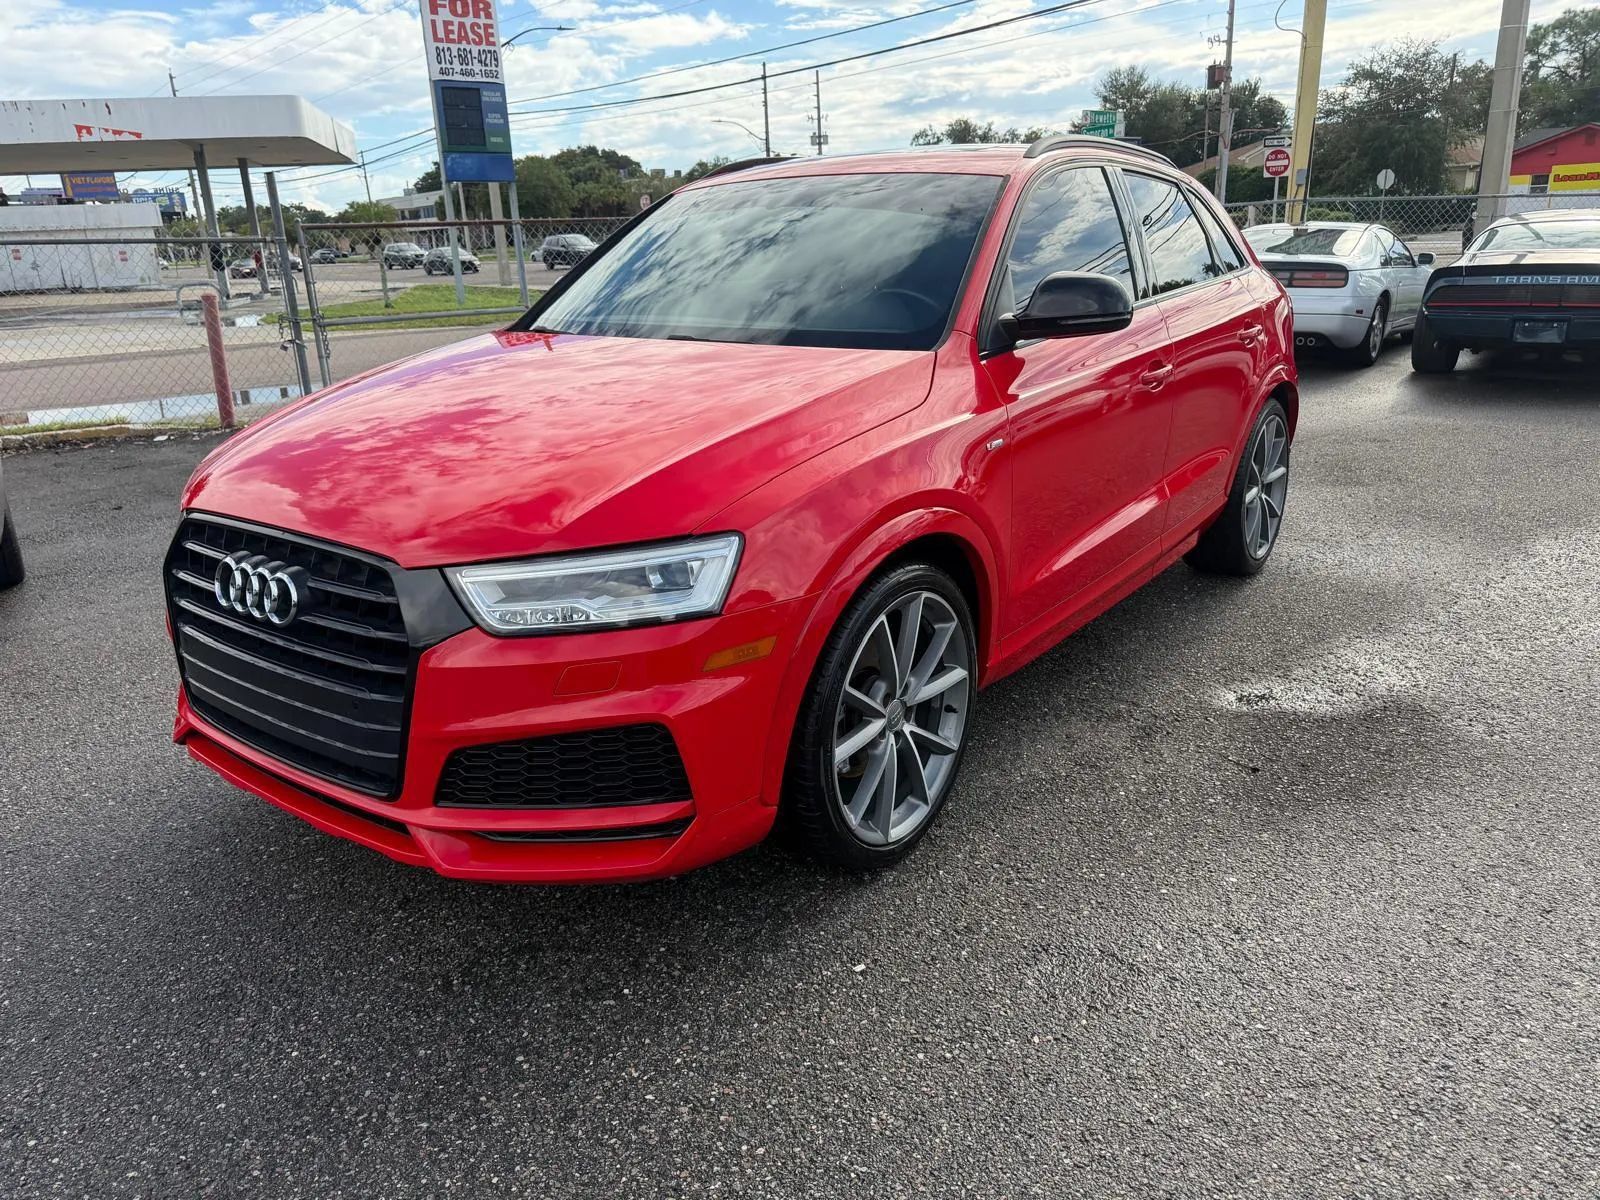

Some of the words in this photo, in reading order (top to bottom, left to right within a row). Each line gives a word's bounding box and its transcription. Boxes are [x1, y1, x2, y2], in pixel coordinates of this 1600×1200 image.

[428, 0, 493, 20] FOR
[430, 19, 496, 47] LEASE
[435, 46, 499, 68] 813-681-4279
[438, 67, 500, 79] 407-460-1652
[1491, 275, 1562, 284] TRANS
[1566, 275, 1600, 284] AM
